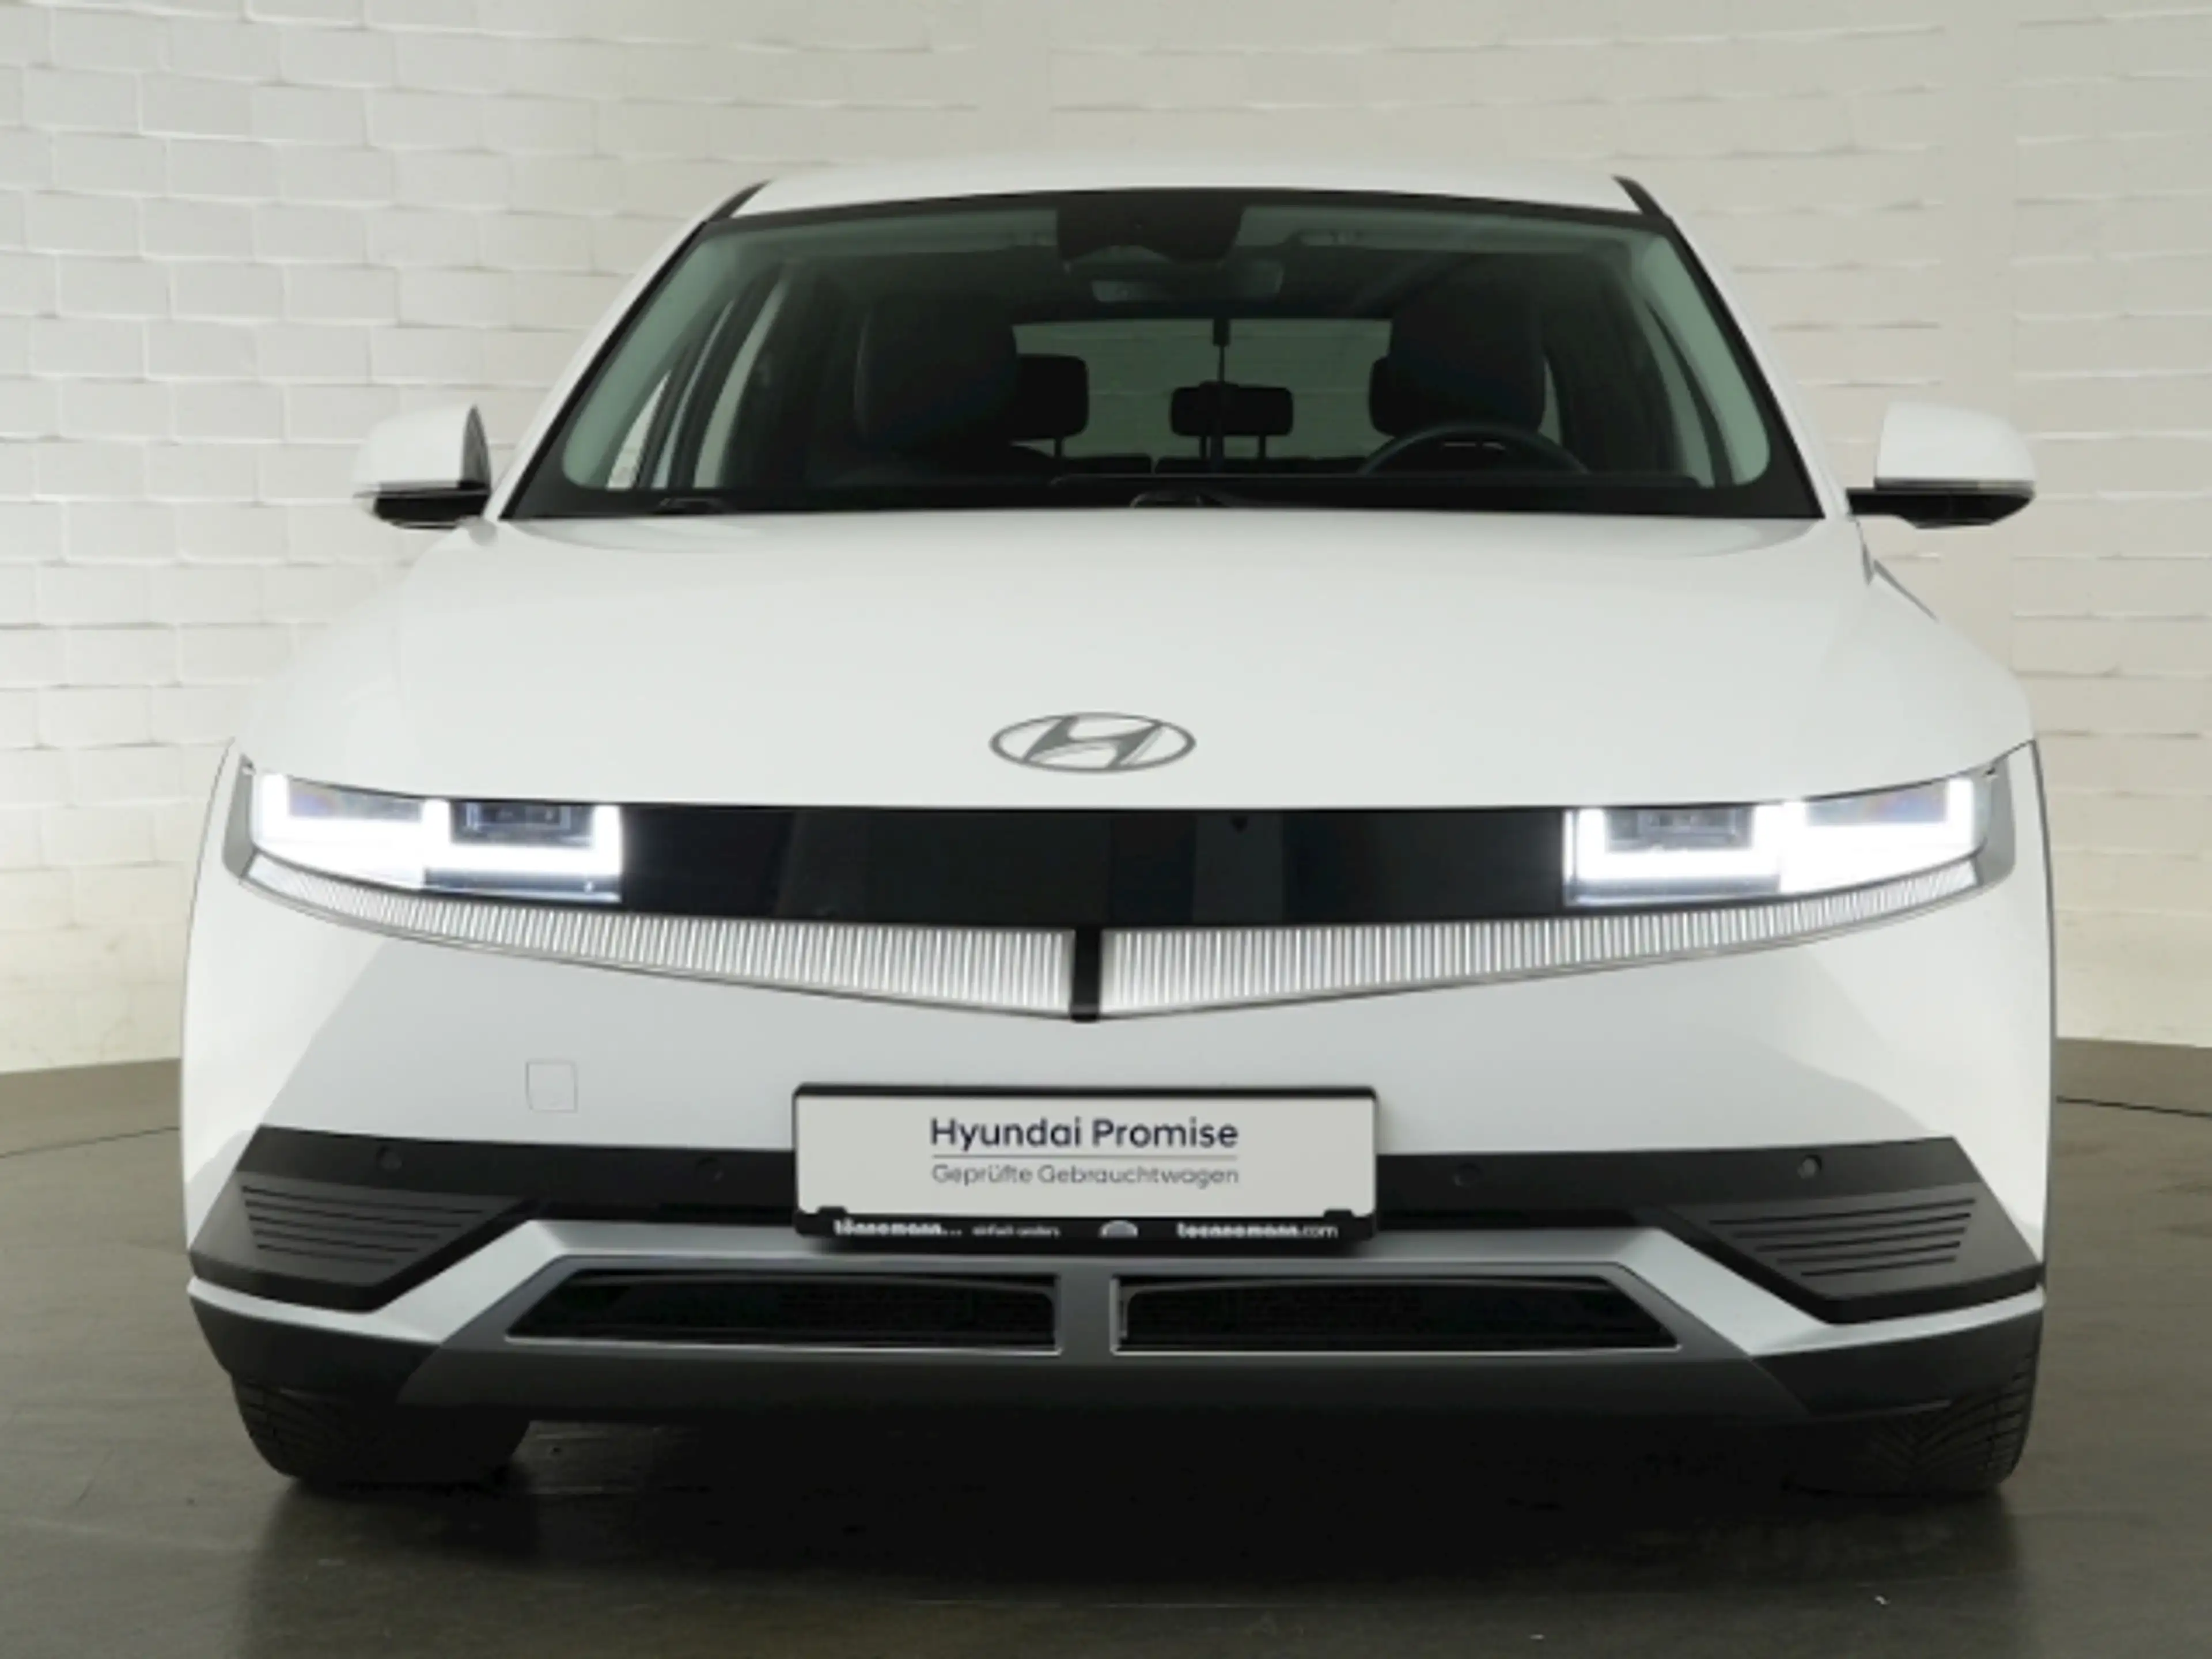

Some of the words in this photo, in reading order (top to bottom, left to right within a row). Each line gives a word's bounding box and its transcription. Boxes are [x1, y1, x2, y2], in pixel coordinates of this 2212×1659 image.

[930, 1117, 1081, 1151] Hyundai
[1093, 1117, 1238, 1147] Promise
[931, 1164, 1033, 1185] Geprüfte
[1037, 1164, 1239, 1189] Gebrauchtwagen
